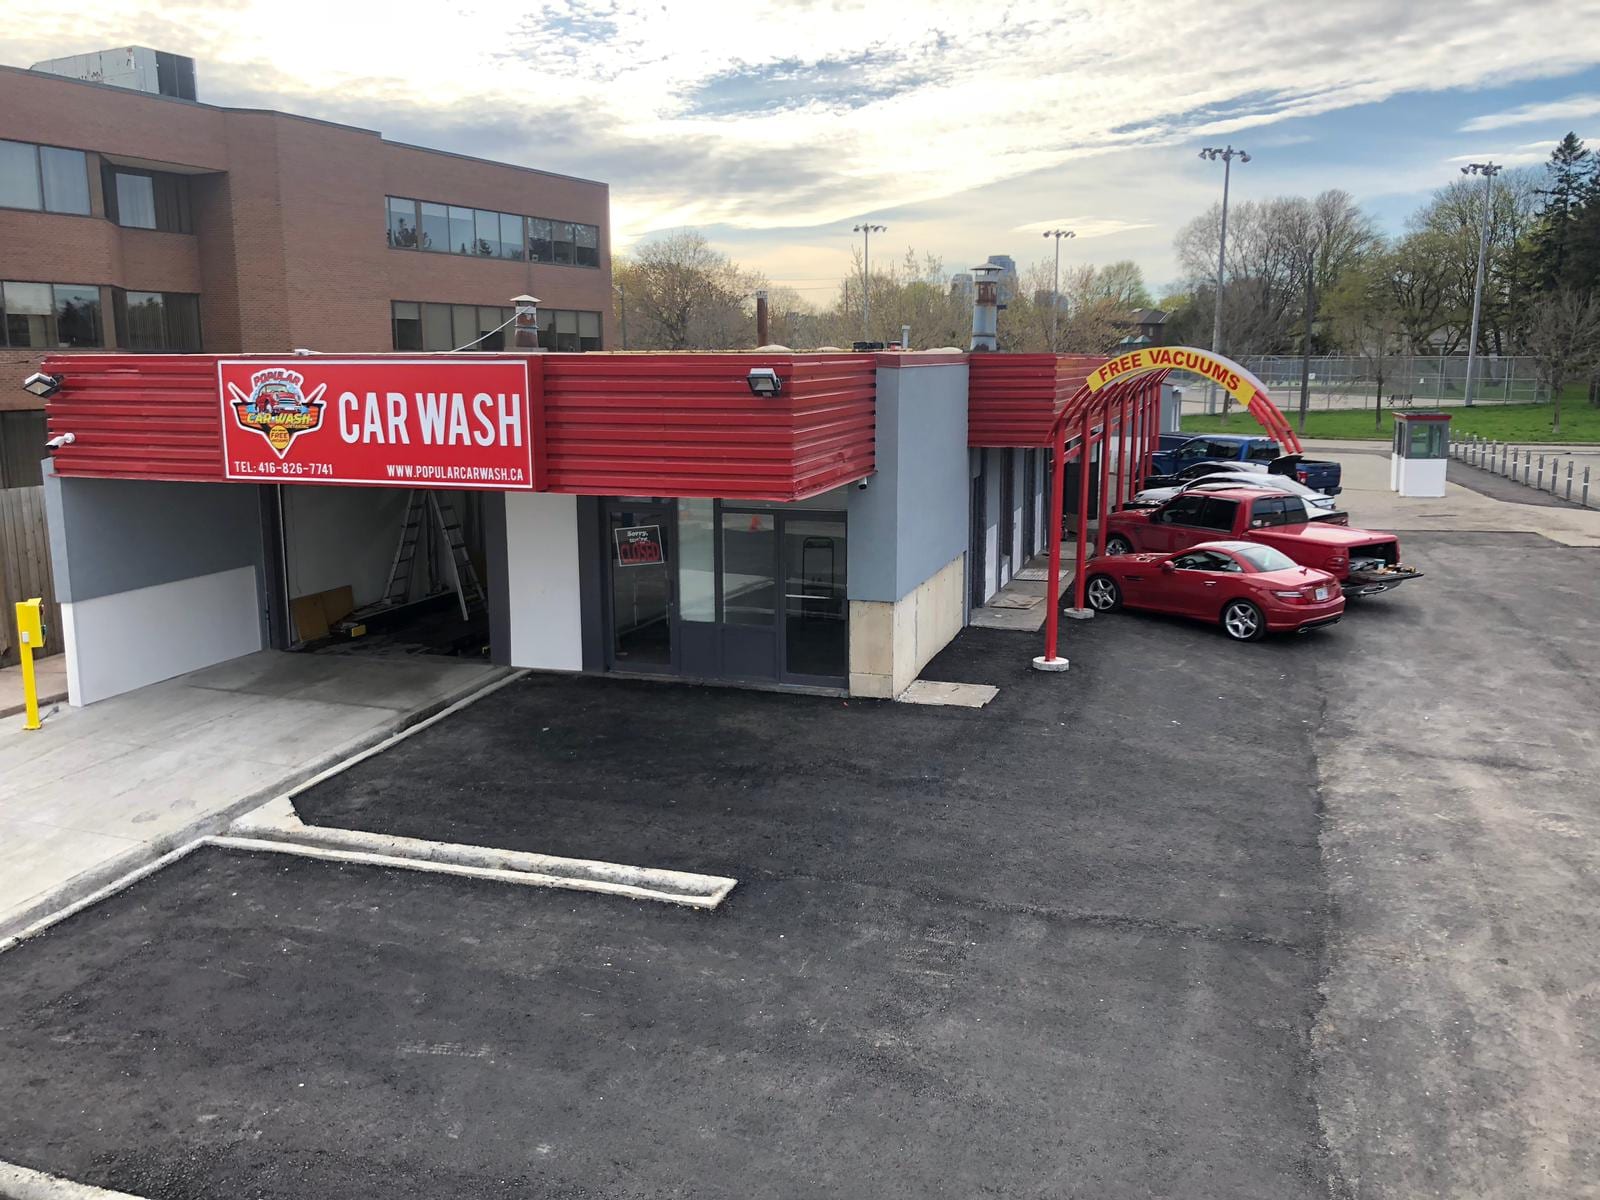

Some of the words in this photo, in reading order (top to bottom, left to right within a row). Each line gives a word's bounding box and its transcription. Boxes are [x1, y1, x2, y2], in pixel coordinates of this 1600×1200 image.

[253, 370, 301, 385] POPULAR
[1098, 353, 1142, 382] FREE
[1148, 350, 1240, 391] VACUUMS
[247, 413, 272, 424] CAR
[275, 413, 311, 424] WASH
[338, 391, 410, 445] CAR
[415, 393, 522, 447] WASH
[234, 461, 256, 473] TEL:
[258, 462, 333, 476] 416-826-7741
[386, 464, 524, 481] WWW.POPULARCARWASH.CA
